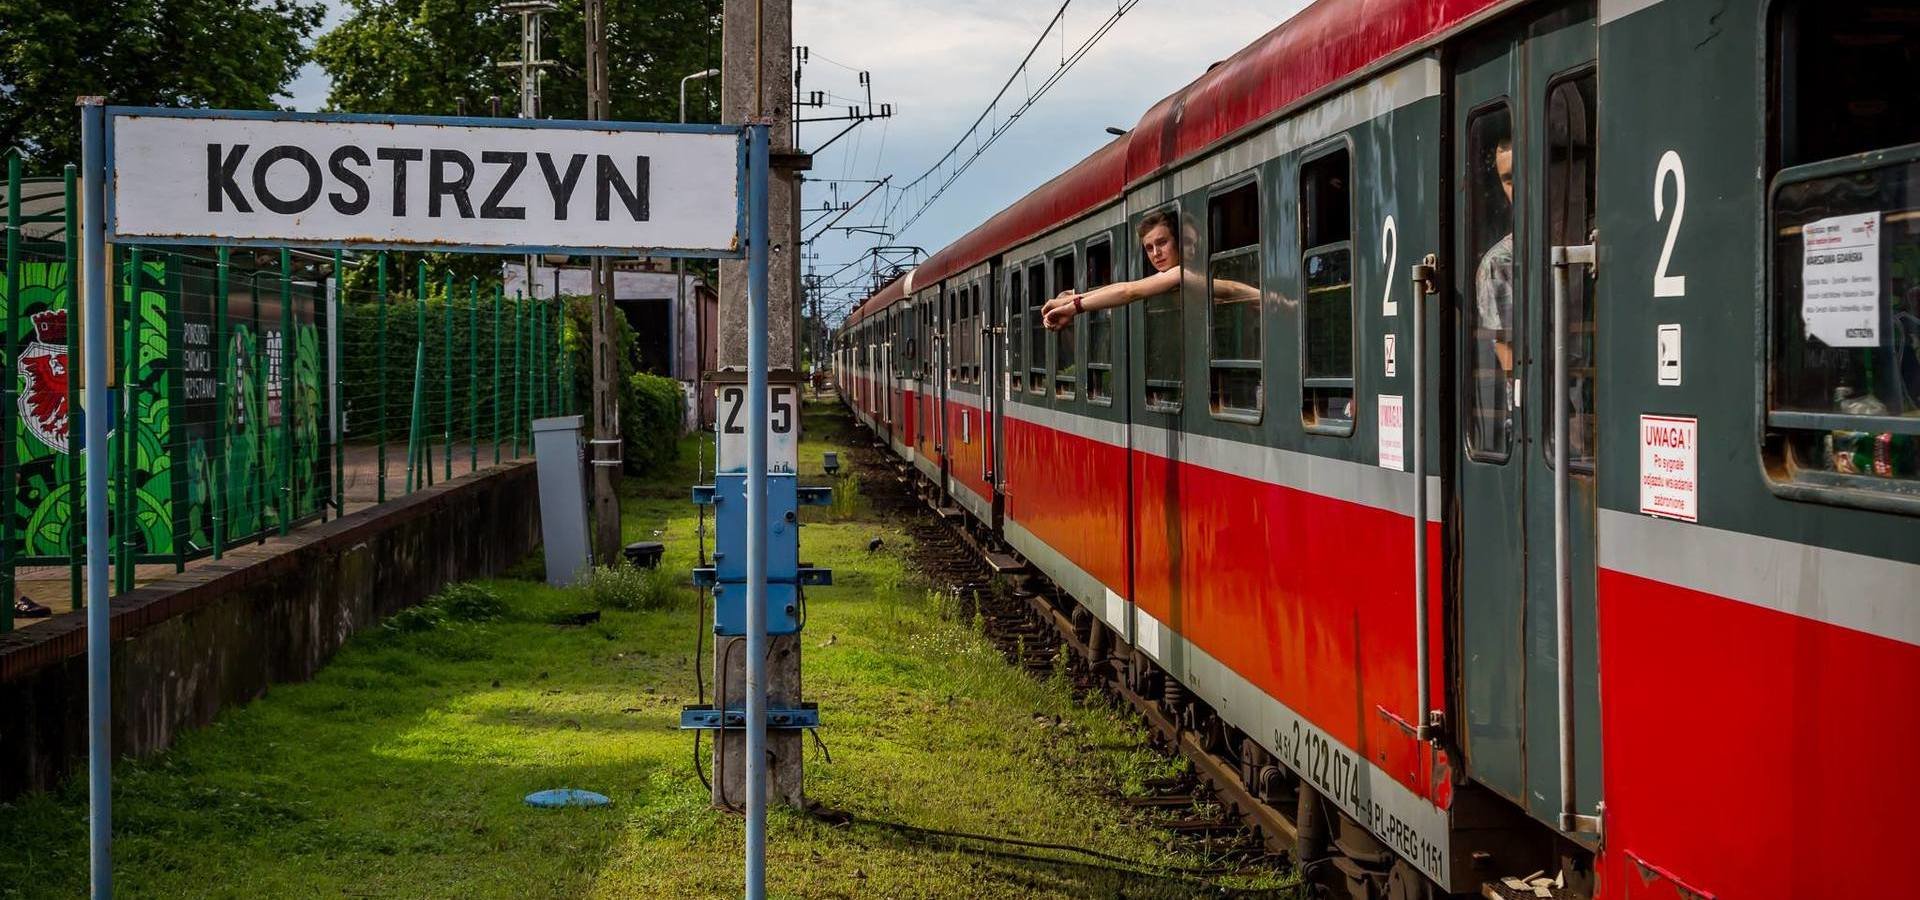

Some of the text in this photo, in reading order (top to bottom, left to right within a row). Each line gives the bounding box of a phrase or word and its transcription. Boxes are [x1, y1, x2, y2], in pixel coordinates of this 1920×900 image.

[207, 143, 650, 222] KOSTRZYN
[1653, 150, 1686, 298] 2
[1382, 214, 1398, 317] 2
[1645, 426, 1685, 449] UWAGA
[1274, 728, 1283, 755] 94
[1283, 735, 1291, 762] 51
[1292, 719, 1302, 770] 2
[1305, 728, 1330, 794] 122
[1374, 802, 1418, 862] PL-PREG
[1420, 837, 1443, 881] 1151
